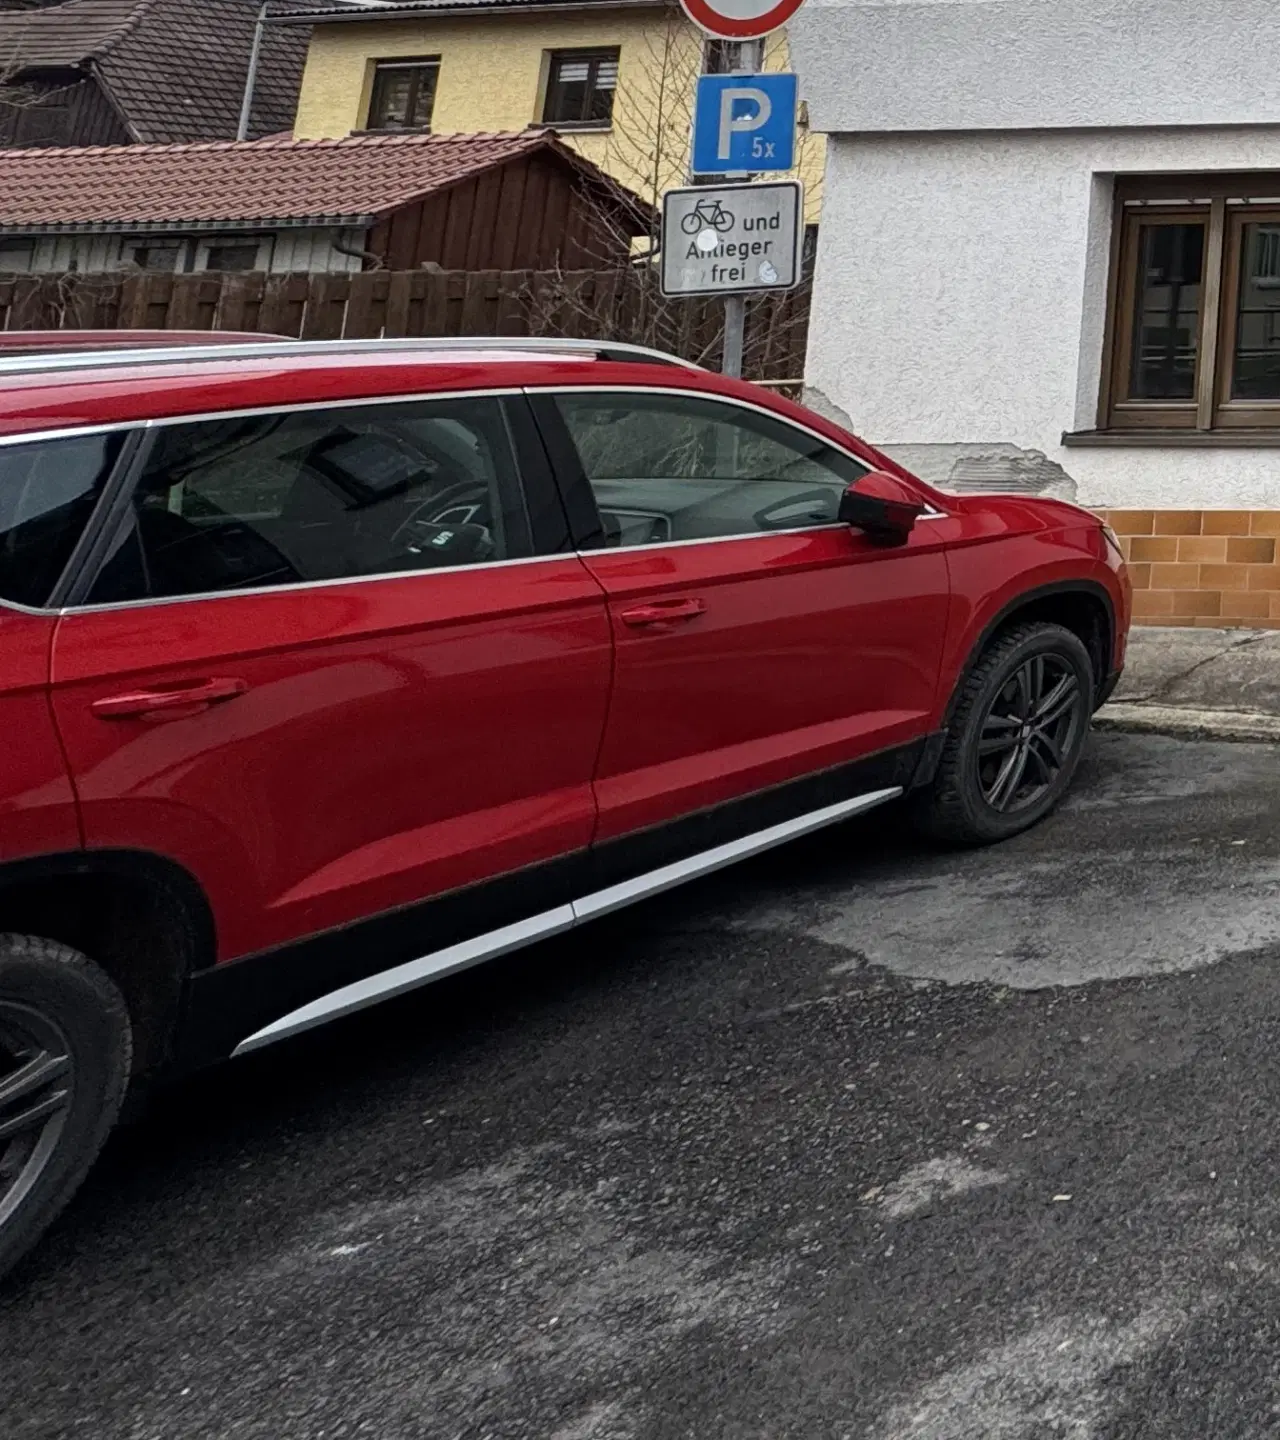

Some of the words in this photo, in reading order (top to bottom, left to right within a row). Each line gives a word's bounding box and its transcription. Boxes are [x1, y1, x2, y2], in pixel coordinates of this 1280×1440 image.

[717, 87, 771, 160] P
[751, 136, 776, 158] 5x
[743, 211, 780, 231] und
[711, 262, 746, 282] frei
